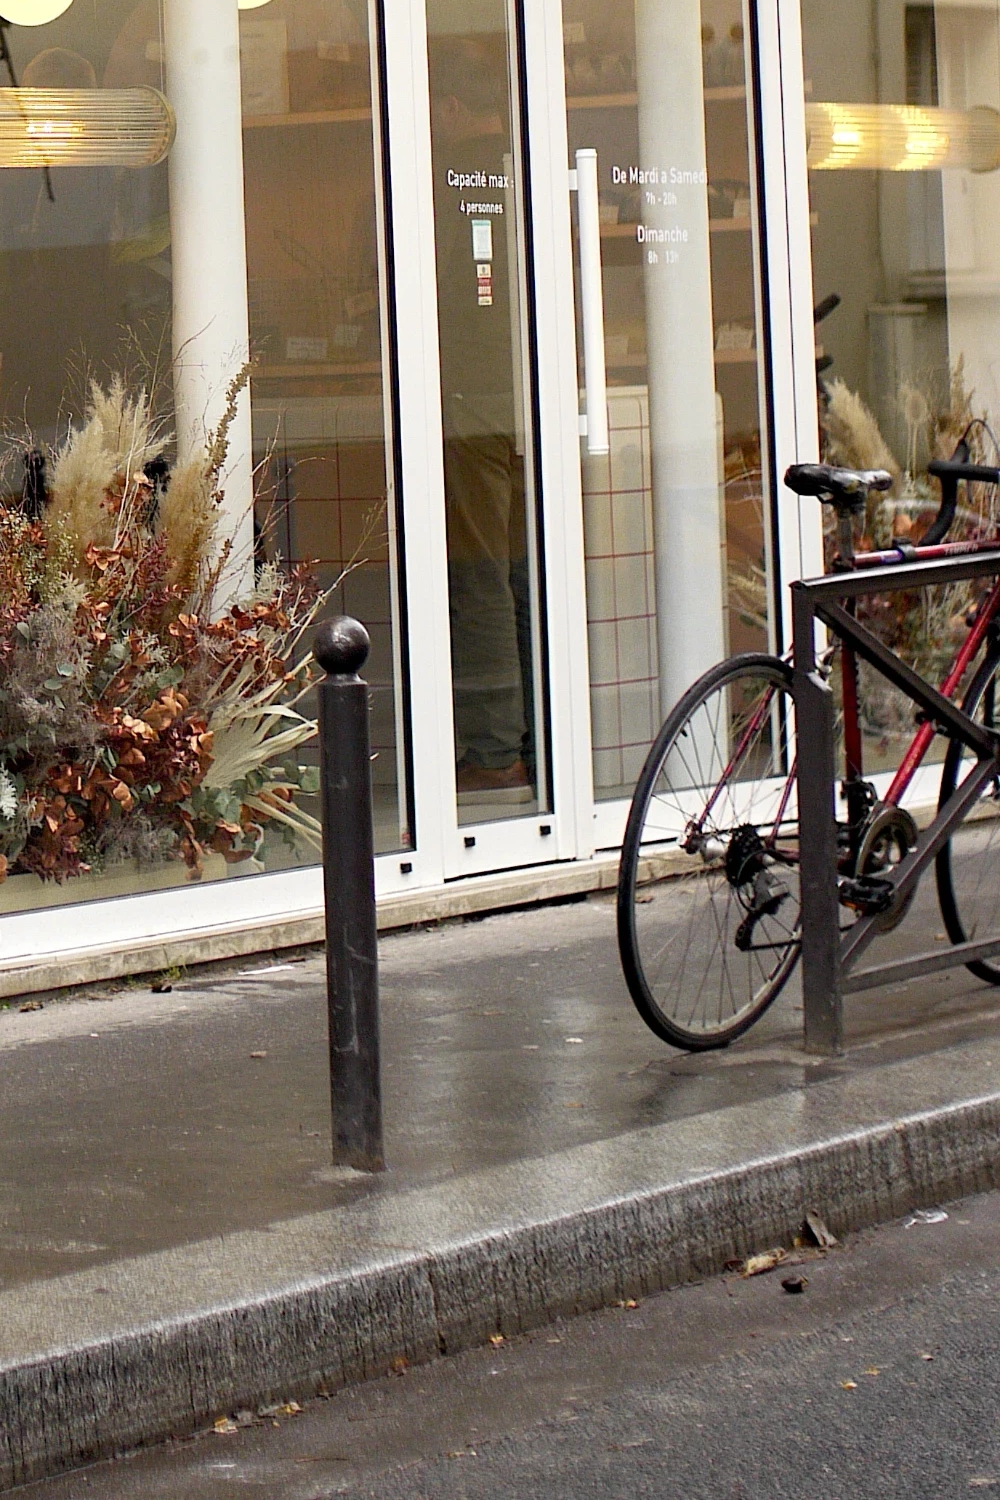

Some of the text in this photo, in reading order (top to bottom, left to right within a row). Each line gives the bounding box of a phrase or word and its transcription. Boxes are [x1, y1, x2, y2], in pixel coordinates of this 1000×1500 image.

[447, 169, 488, 191] Capacité
[488, 174, 509, 189] max
[612, 166, 627, 184] De
[629, 166, 659, 185] Mardi
[459, 199, 504, 216] 4 personnes
[636, 224, 689, 243] Dimanche
